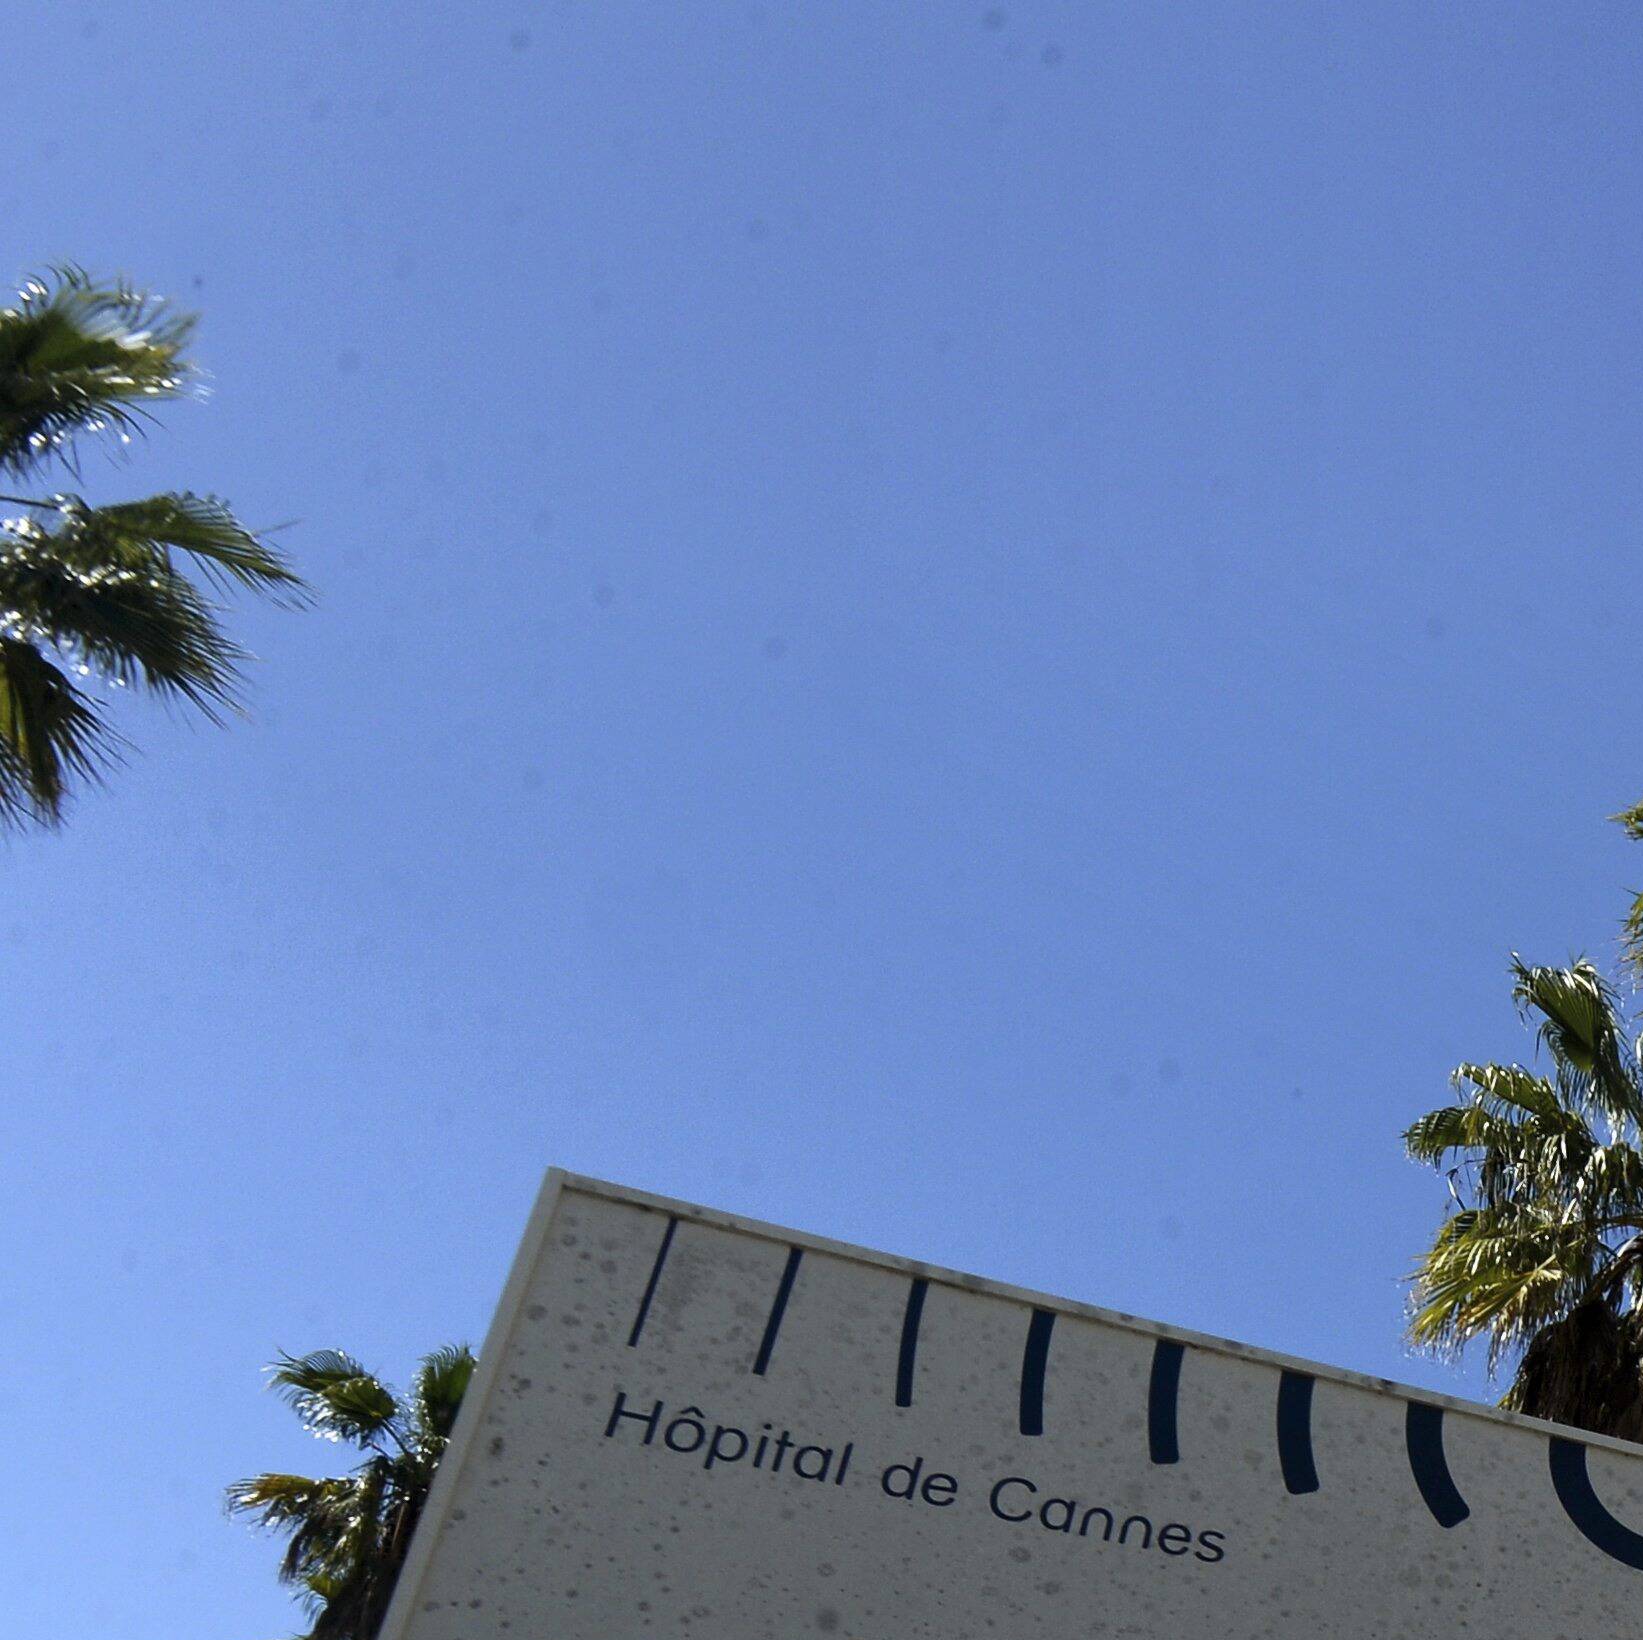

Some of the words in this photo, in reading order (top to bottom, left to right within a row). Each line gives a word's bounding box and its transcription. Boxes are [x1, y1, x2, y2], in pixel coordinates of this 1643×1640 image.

[603, 1391, 854, 1486] Hôpital
[880, 1456, 959, 1507] de
[989, 1476, 1226, 1563] Cannes
